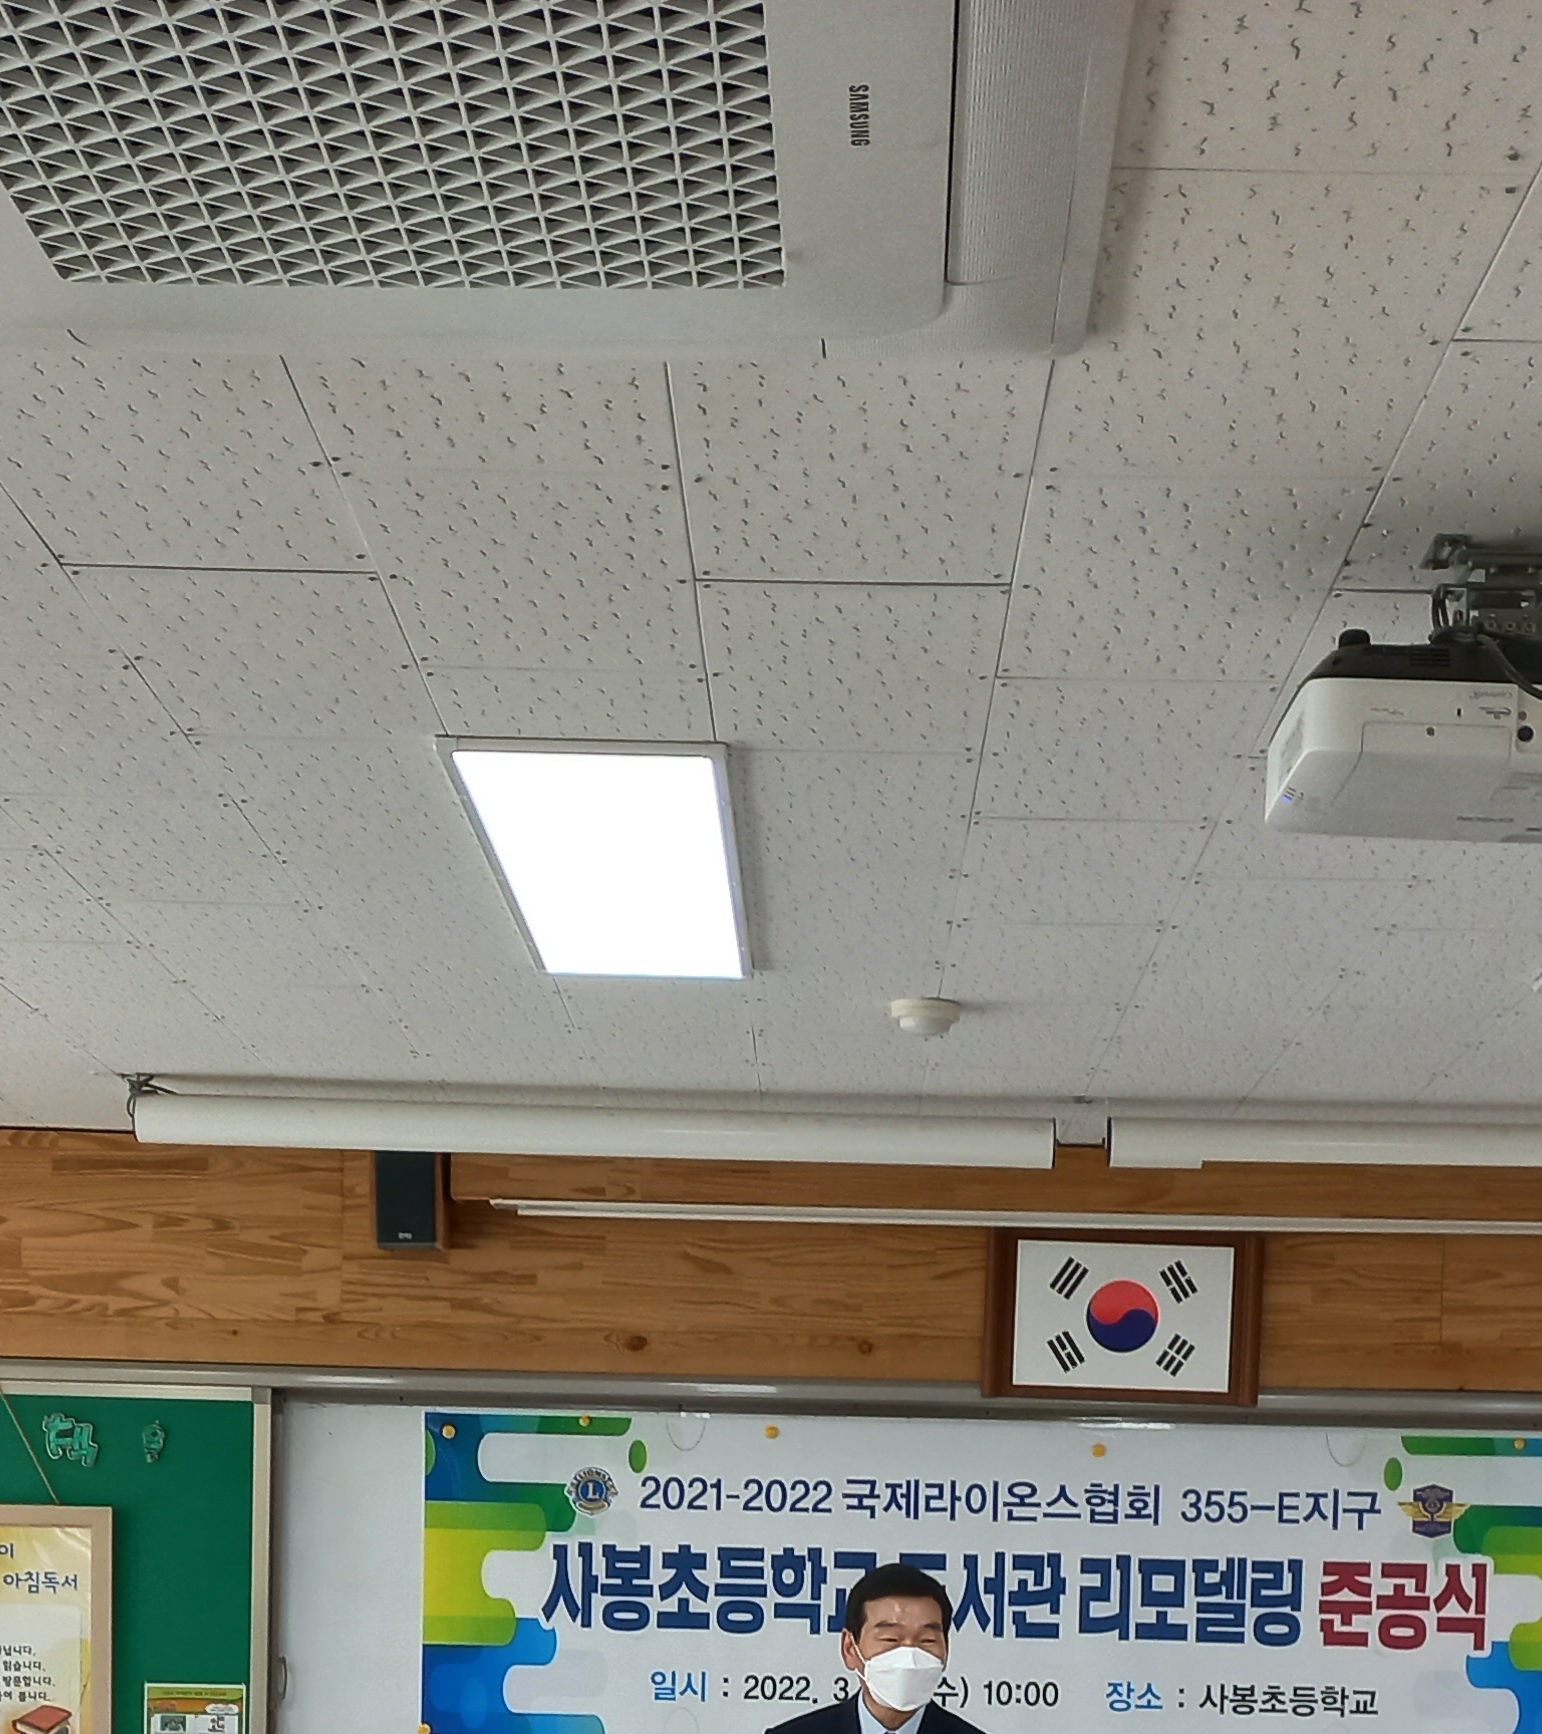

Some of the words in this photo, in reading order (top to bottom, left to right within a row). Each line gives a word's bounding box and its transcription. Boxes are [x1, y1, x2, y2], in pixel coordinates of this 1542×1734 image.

[848, 84, 870, 147] SAMSUNG
[639, 1476, 834, 1514] 2021-2022
[841, 1478, 1162, 1526] 국제라이온스협회
[1180, 1487, 1382, 1531] 355-E지구
[3, 1571, 79, 1594] 아침독서
[1077, 1554, 1304, 1647] 리모델링
[1318, 1560, 1488, 1652] 준공식
[650, 1670, 707, 1703] 일시
[743, 1675, 819, 1704] 2022.
[983, 1680, 1059, 1707] 10:00
[1105, 1681, 1164, 1711] 장소
[1198, 1684, 1379, 1718] 사봉초등학교
